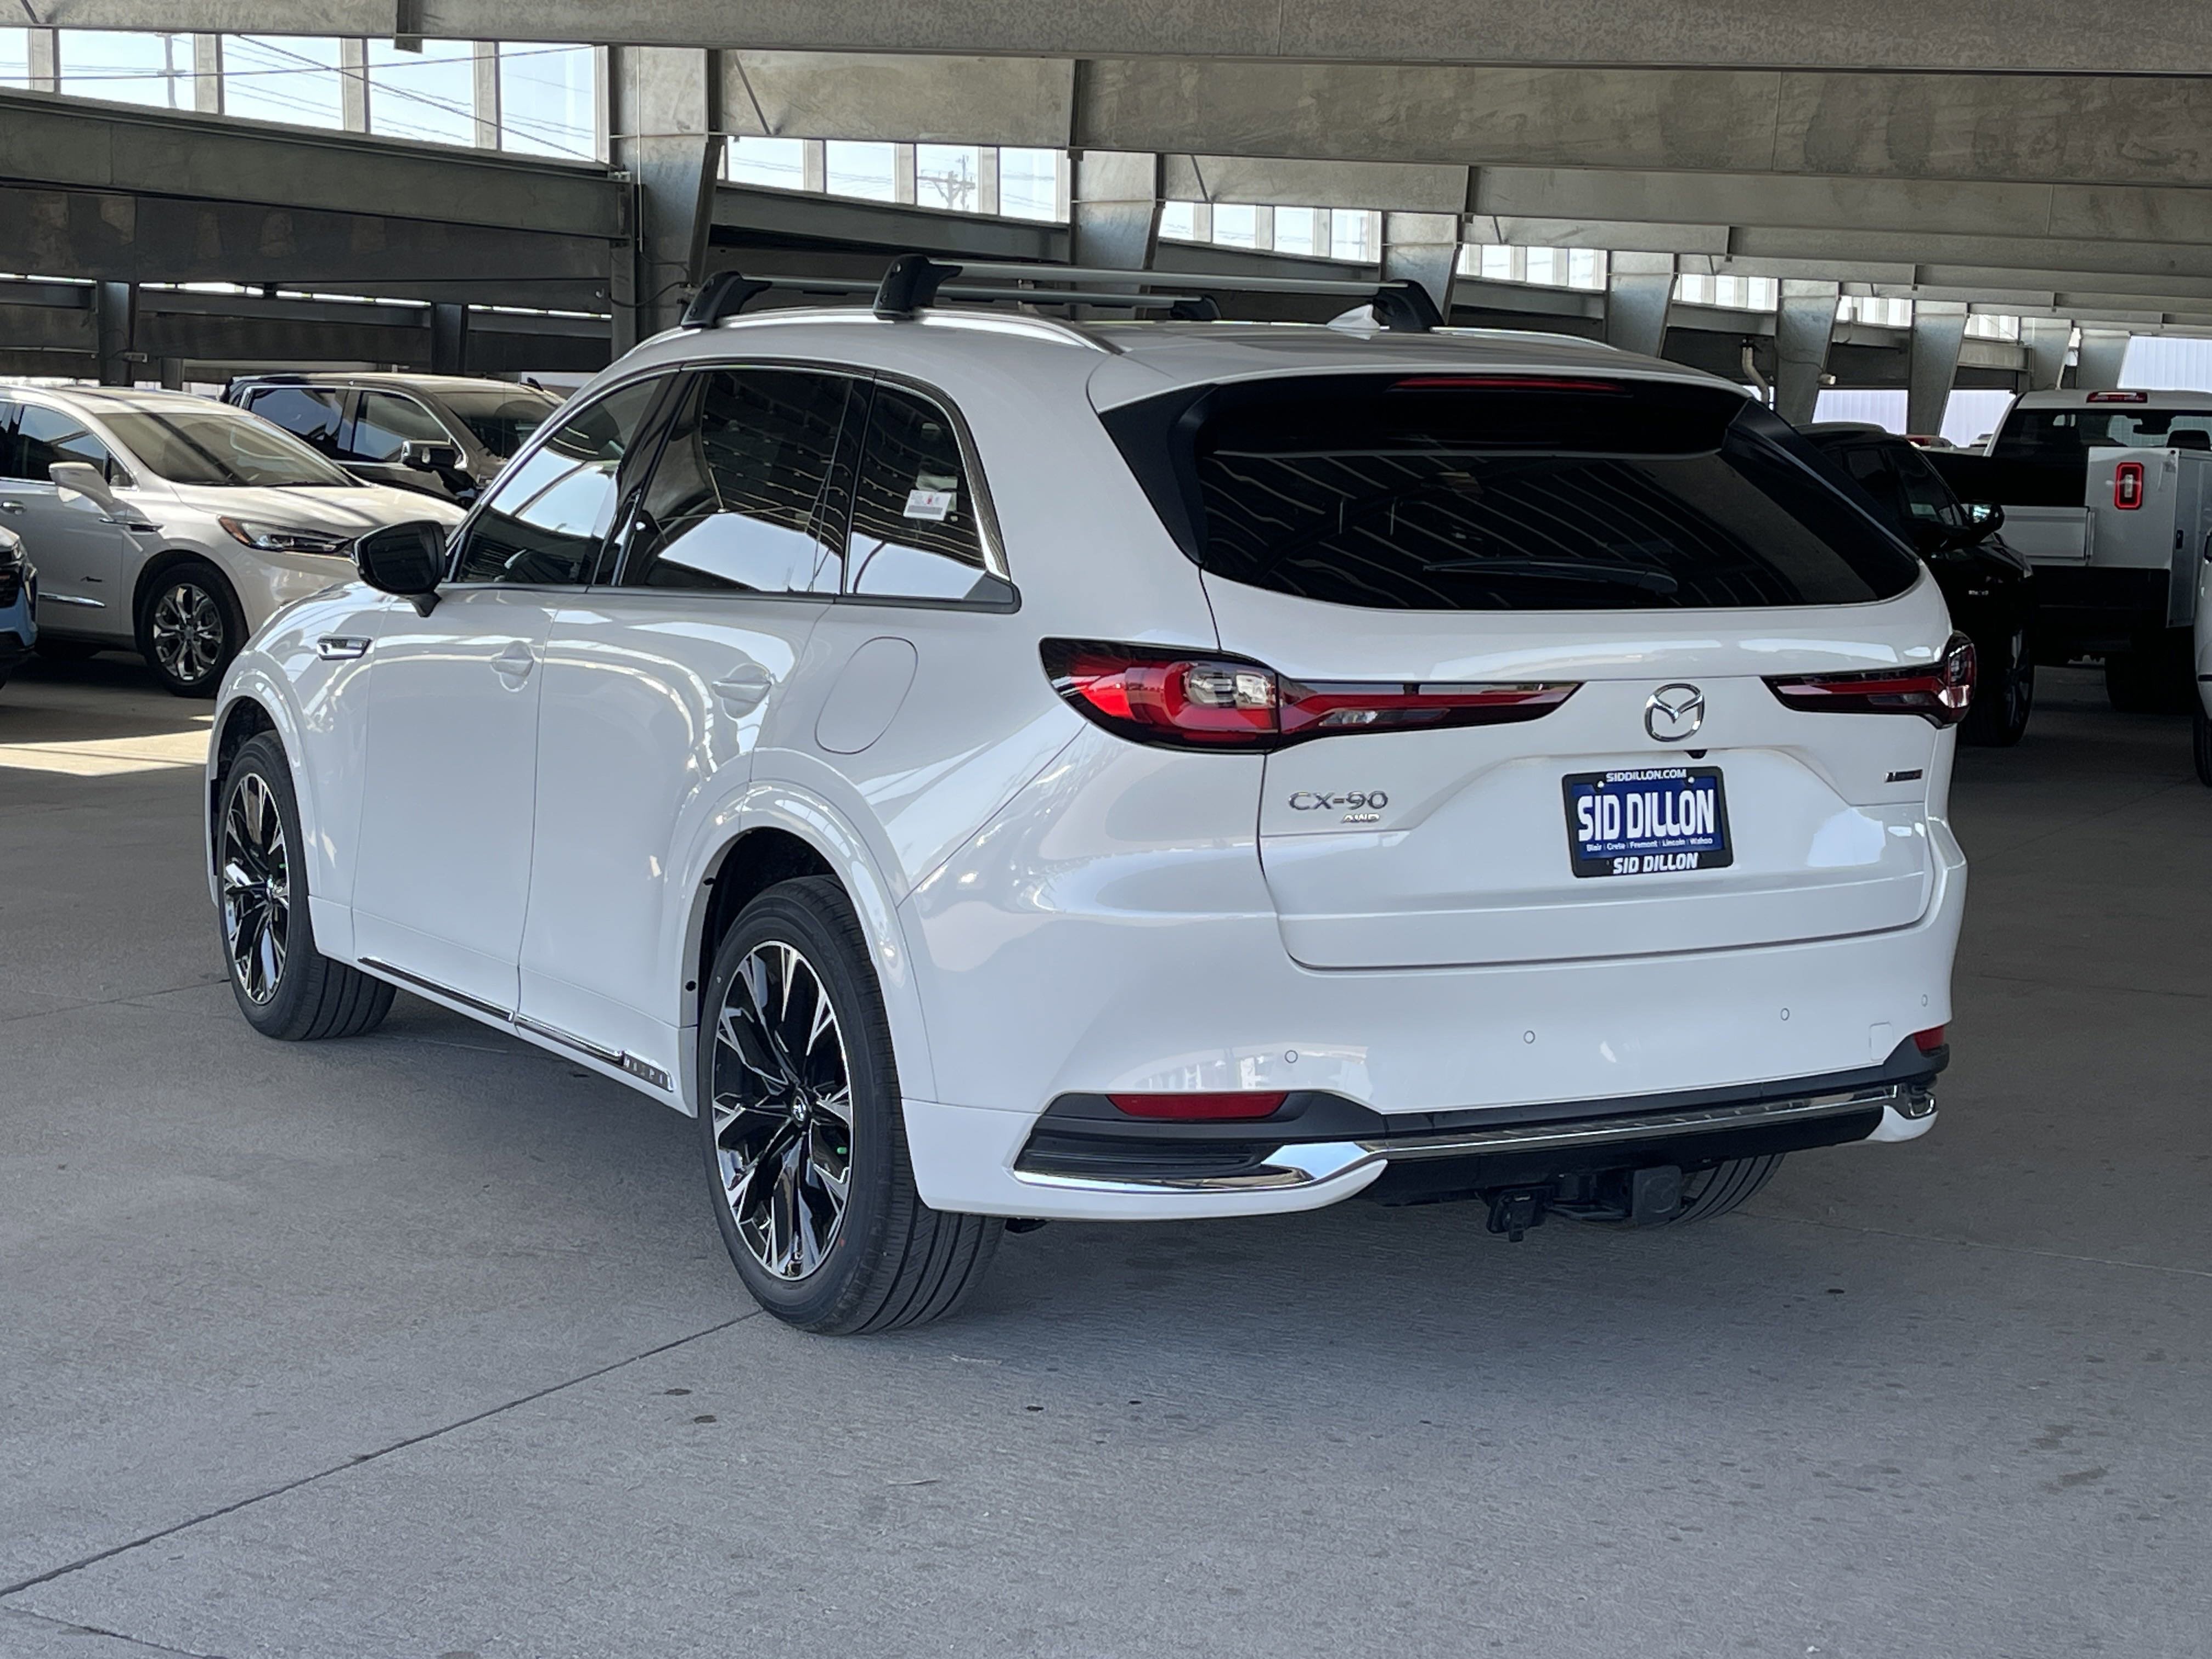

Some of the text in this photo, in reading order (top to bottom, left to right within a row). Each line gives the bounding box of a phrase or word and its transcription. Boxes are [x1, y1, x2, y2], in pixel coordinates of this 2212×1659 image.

[1605, 769, 1687, 782] SIDDILLON.COM
[1289, 791, 1389, 810] CX-90
[1341, 813, 1380, 823] AWD
[1577, 789, 1714, 842] SID DILLON
[1613, 852, 1699, 874] SID DILLON
